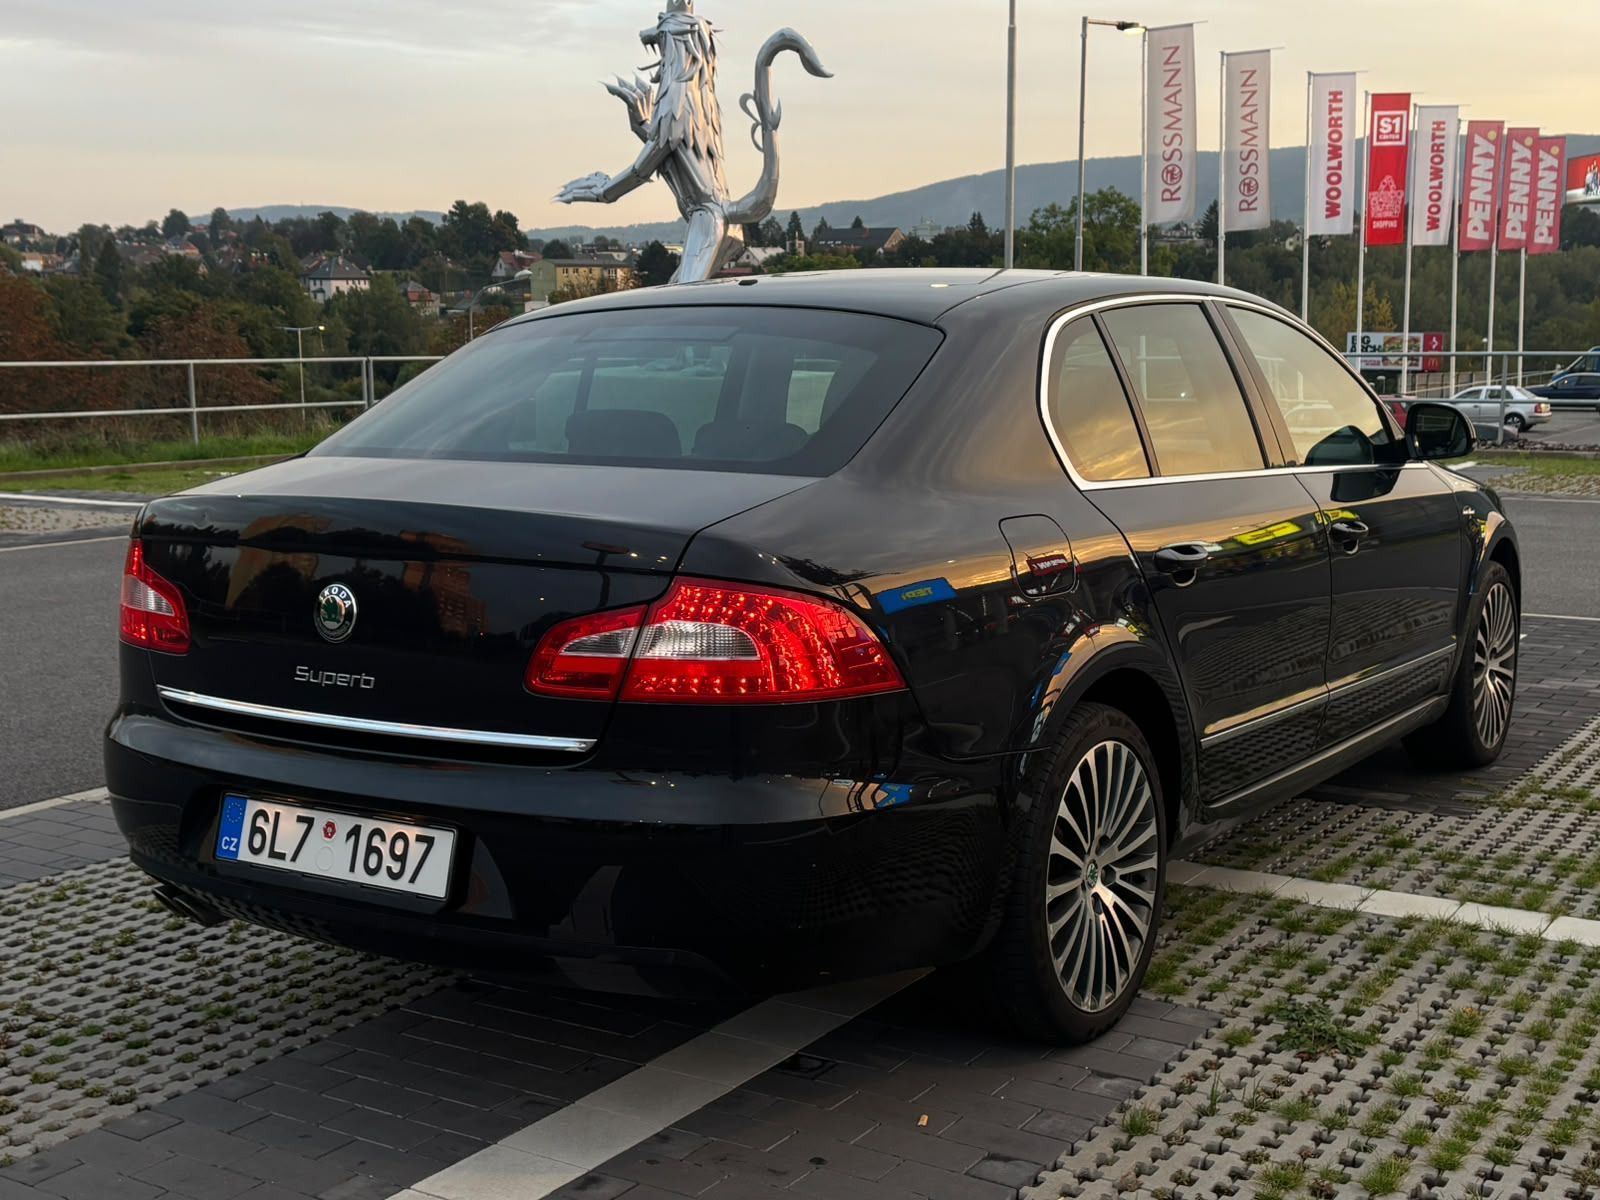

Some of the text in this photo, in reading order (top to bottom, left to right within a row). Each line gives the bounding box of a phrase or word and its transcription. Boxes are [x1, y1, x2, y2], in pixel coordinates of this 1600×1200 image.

[1161, 45, 1183, 202] ROSSMANN
[1239, 69, 1259, 212] ROSSMANN
[1325, 90, 1343, 219] WOOLWORTH
[1379, 116, 1401, 134] S1
[1426, 121, 1446, 232] WOOLWORTH
[294, 665, 375, 688] Superb
[221, 836, 238, 851] CZ
[247, 808, 435, 884] 6L7 1697
